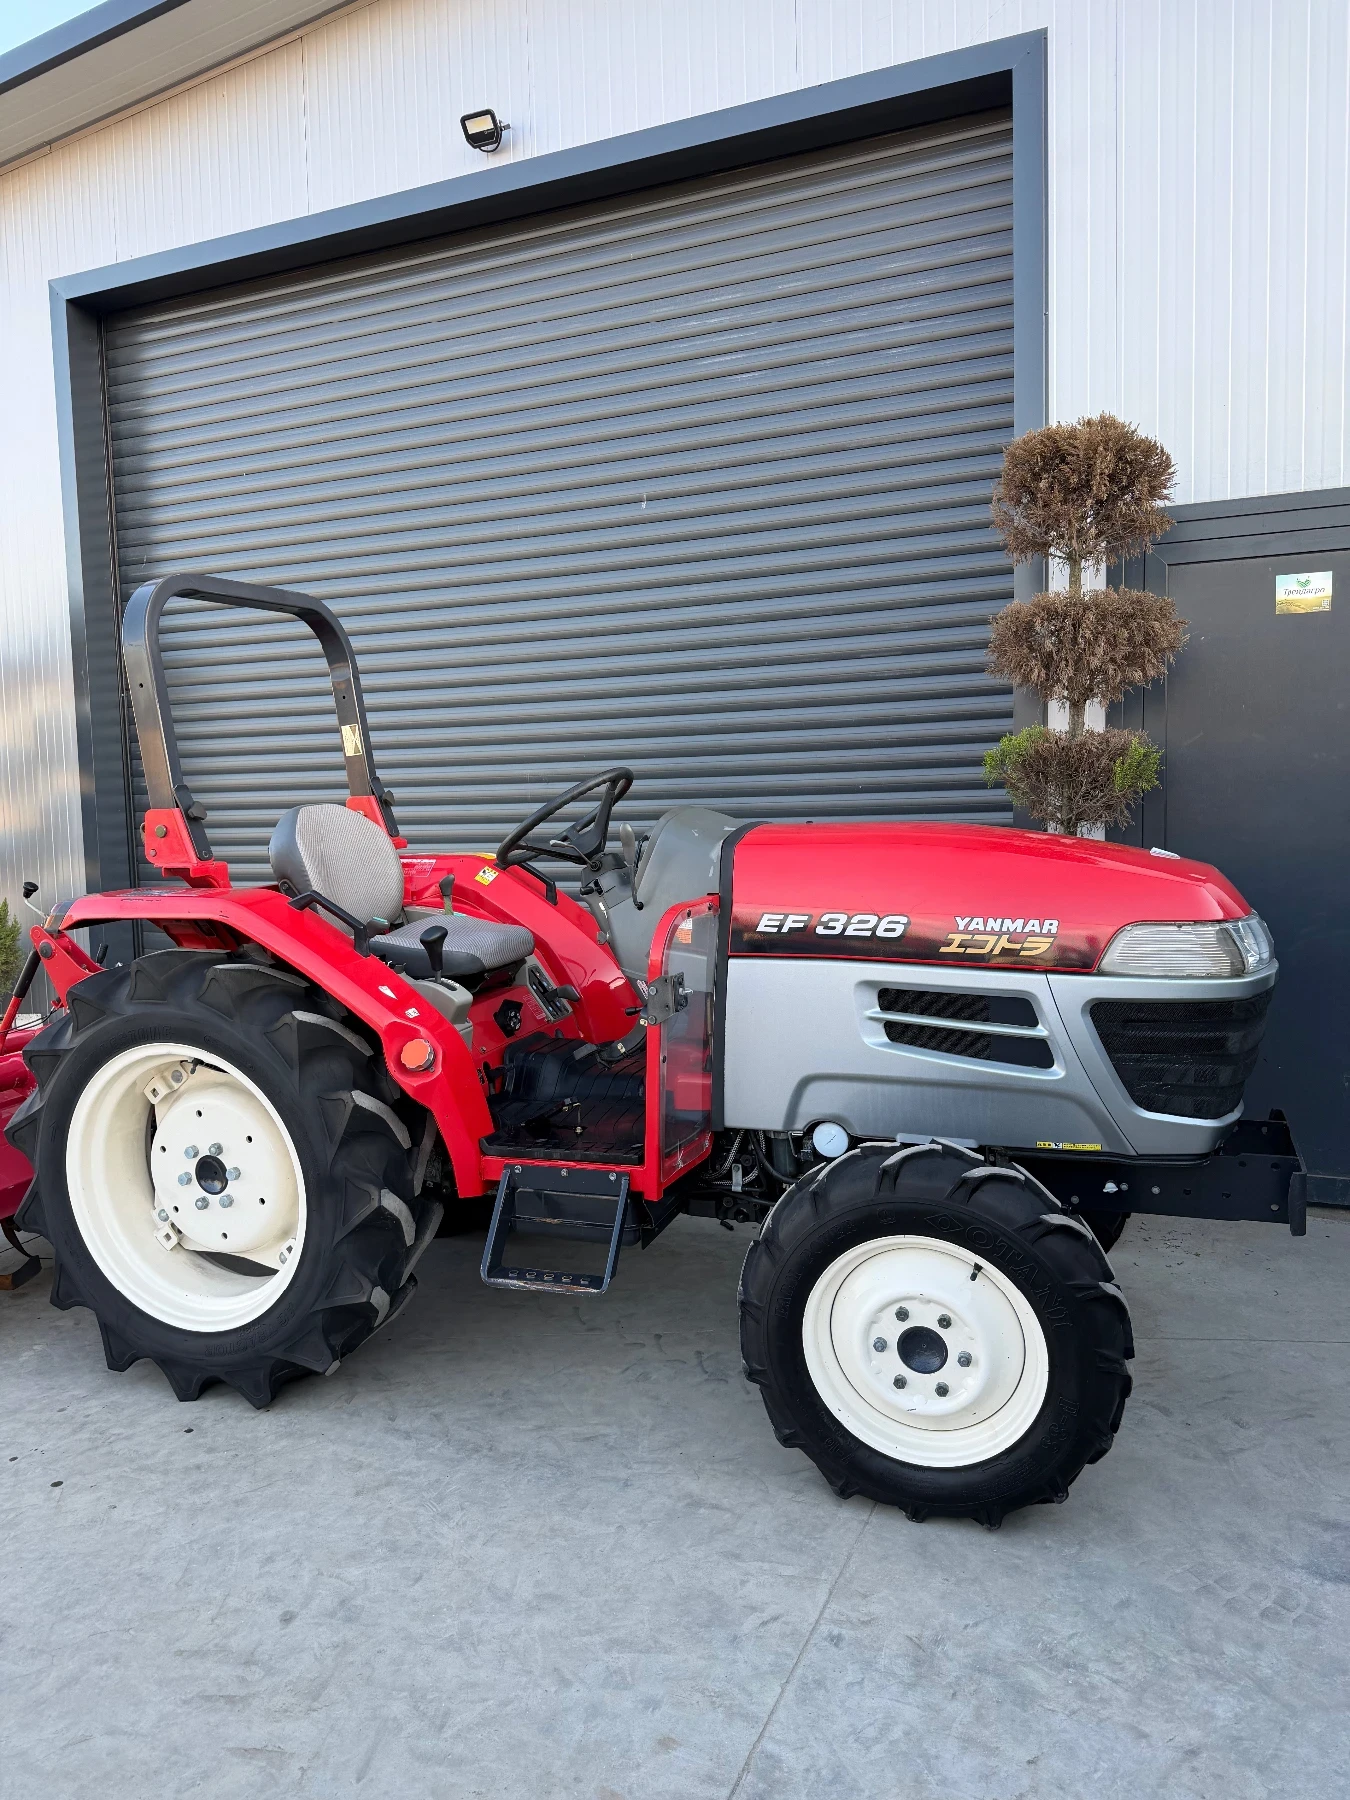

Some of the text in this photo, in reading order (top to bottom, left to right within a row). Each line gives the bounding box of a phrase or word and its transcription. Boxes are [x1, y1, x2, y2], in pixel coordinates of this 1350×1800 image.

[755, 913, 908, 938] EF 326
[953, 916, 1059, 934] YANMAR
[938, 934, 1055, 956] エコトラ
[966, 1225, 1074, 1331] OTANI
